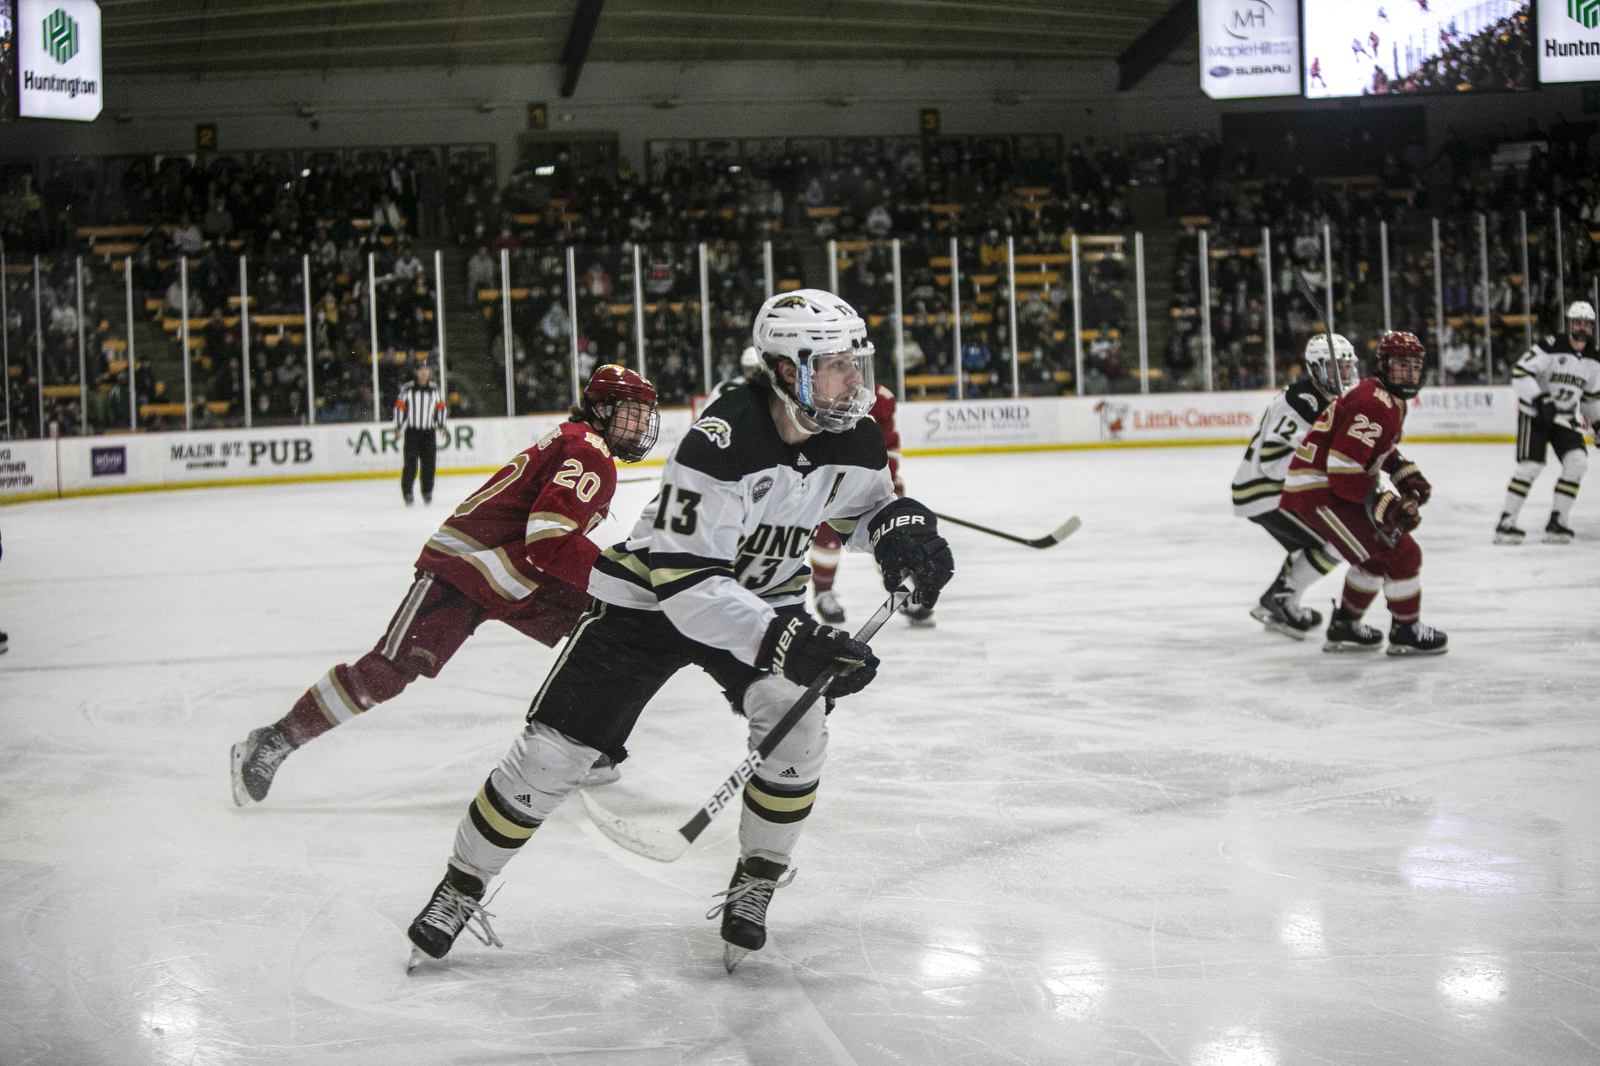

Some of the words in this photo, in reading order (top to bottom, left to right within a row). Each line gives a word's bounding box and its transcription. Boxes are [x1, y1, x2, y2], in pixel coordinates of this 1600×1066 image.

[24, 70, 97, 98] Huntington
[1235, 64, 1291, 76] SUBARU
[947, 404, 1030, 422] SANFORD
[1133, 409, 1178, 430] Little
[1183, 407, 1254, 428] Caesars
[353, 425, 476, 455] AROR
[1273, 415, 1298, 441] 12
[1347, 414, 1382, 448] 22
[171, 441, 214, 461] MAIN
[248, 437, 314, 466] PUB
[553, 458, 601, 503] 20
[653, 483, 702, 536] 13
[733, 553, 783, 591] 13
[704, 750, 764, 819] BAUER
